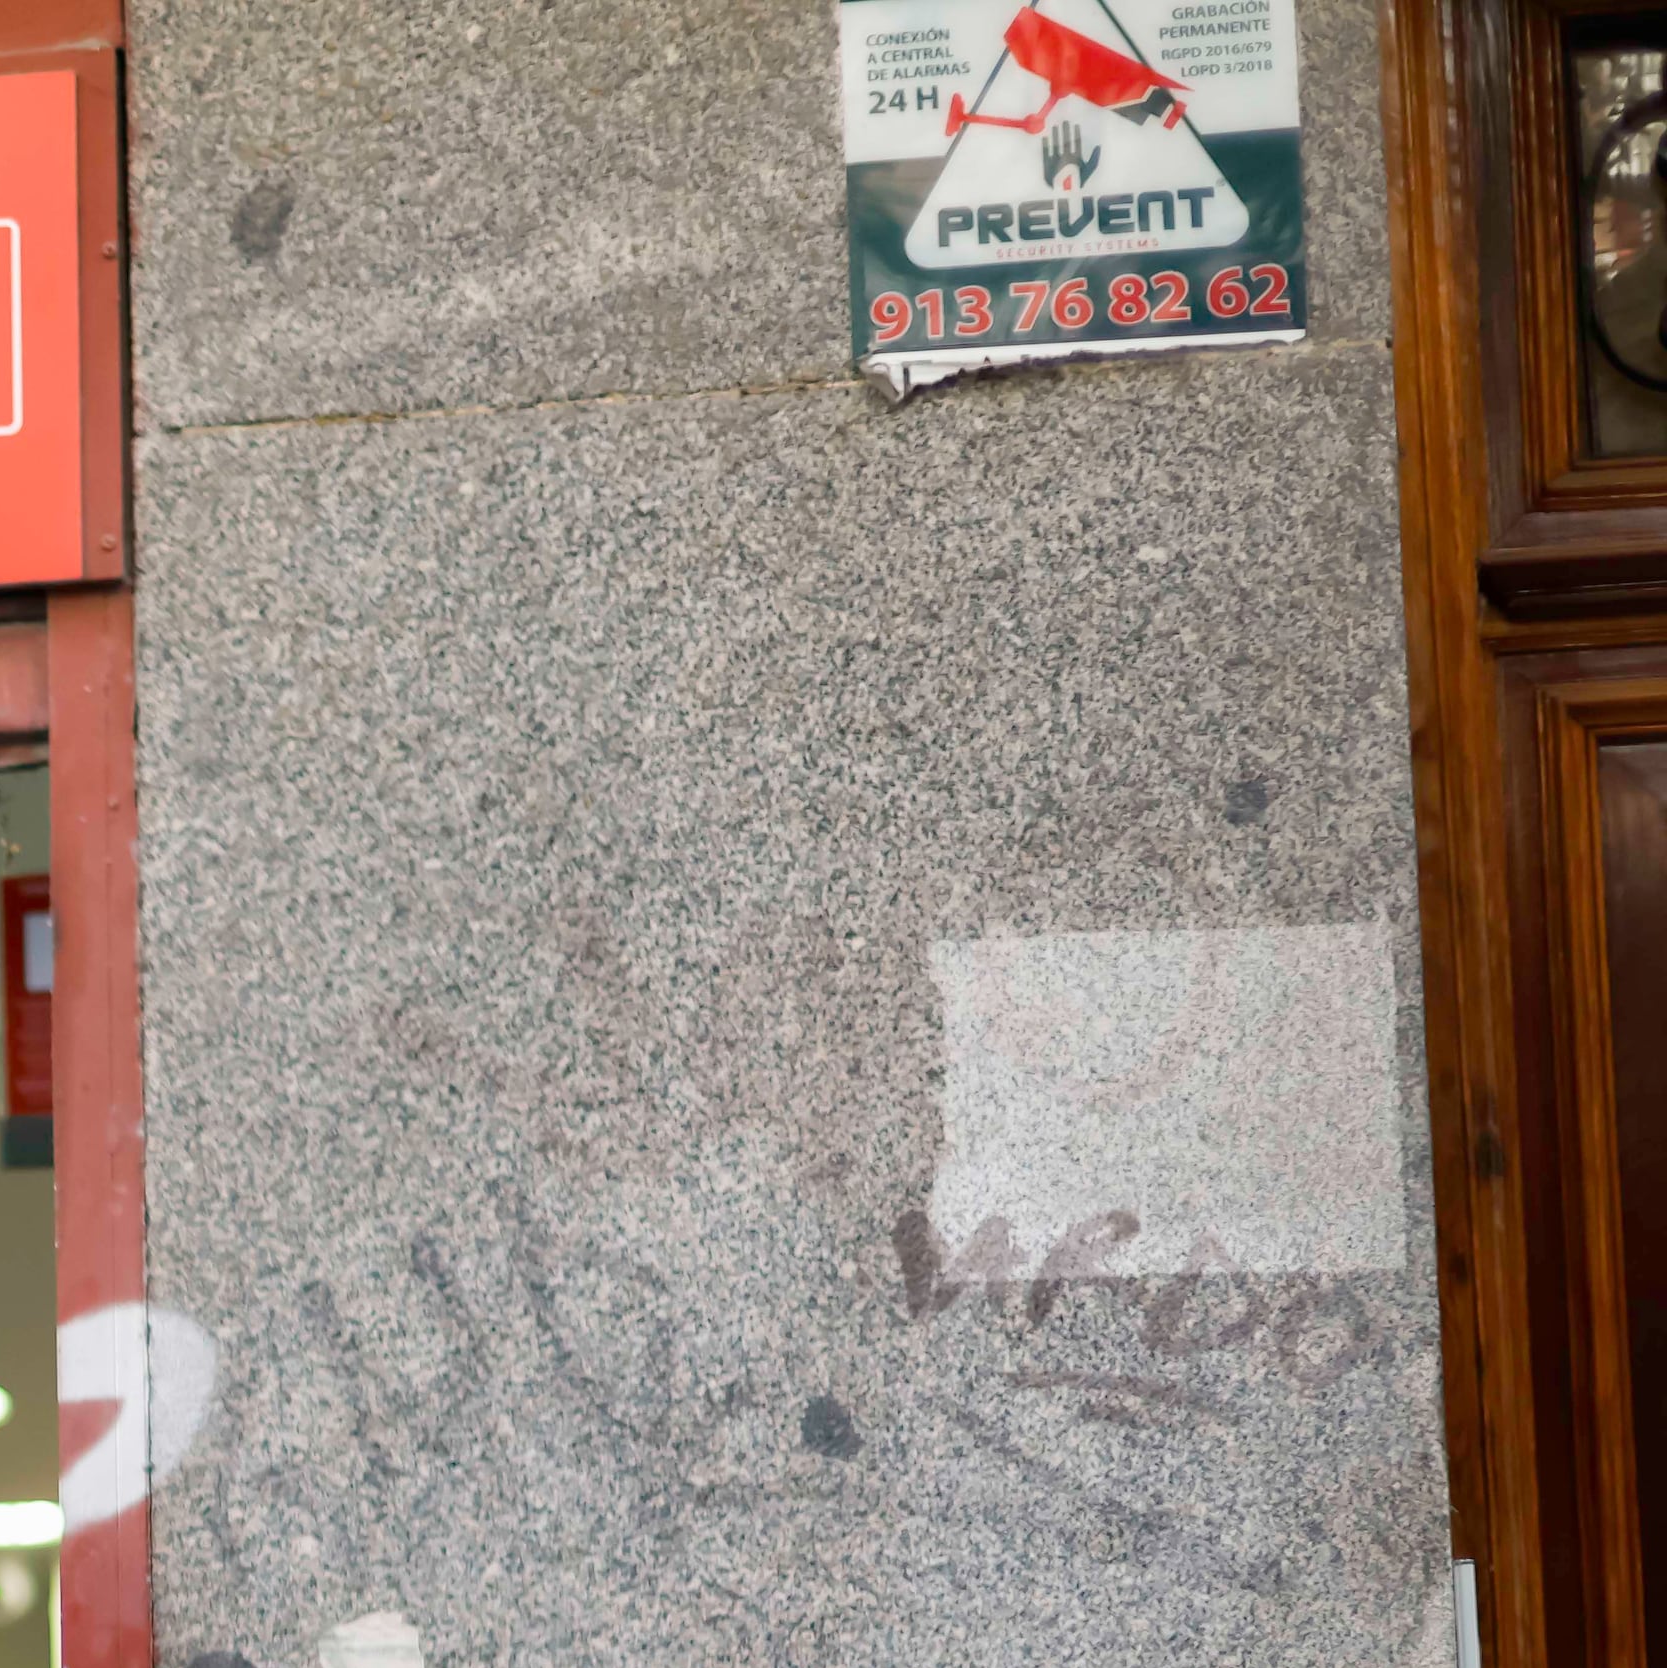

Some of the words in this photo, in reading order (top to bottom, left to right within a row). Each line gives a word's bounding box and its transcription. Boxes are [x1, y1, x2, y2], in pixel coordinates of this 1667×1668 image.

[1171, 1, 1271, 21] GRABACIÓN
[866, 27, 950, 47] CONEXIÓN
[1159, 18, 1272, 40] PERMANENTE
[867, 53, 877, 64] A
[881, 46, 954, 64] CENTRAL
[1161, 46, 1202, 60] RGPD
[1205, 40, 1273, 57] 2016/679
[867, 68, 888, 82] DE
[892, 61, 971, 80] ALARMAS
[1180, 63, 1221, 78] LOPD
[1224, 59, 1274, 74] 3/2018
[868, 88, 907, 115] 24
[916, 84, 940, 111] H
[938, 186, 1216, 248] PREVENT
[870, 286, 994, 344] 913
[1010, 278, 1095, 333] 76
[1107, 271, 1191, 326] 82
[1206, 263, 1292, 319] 62
